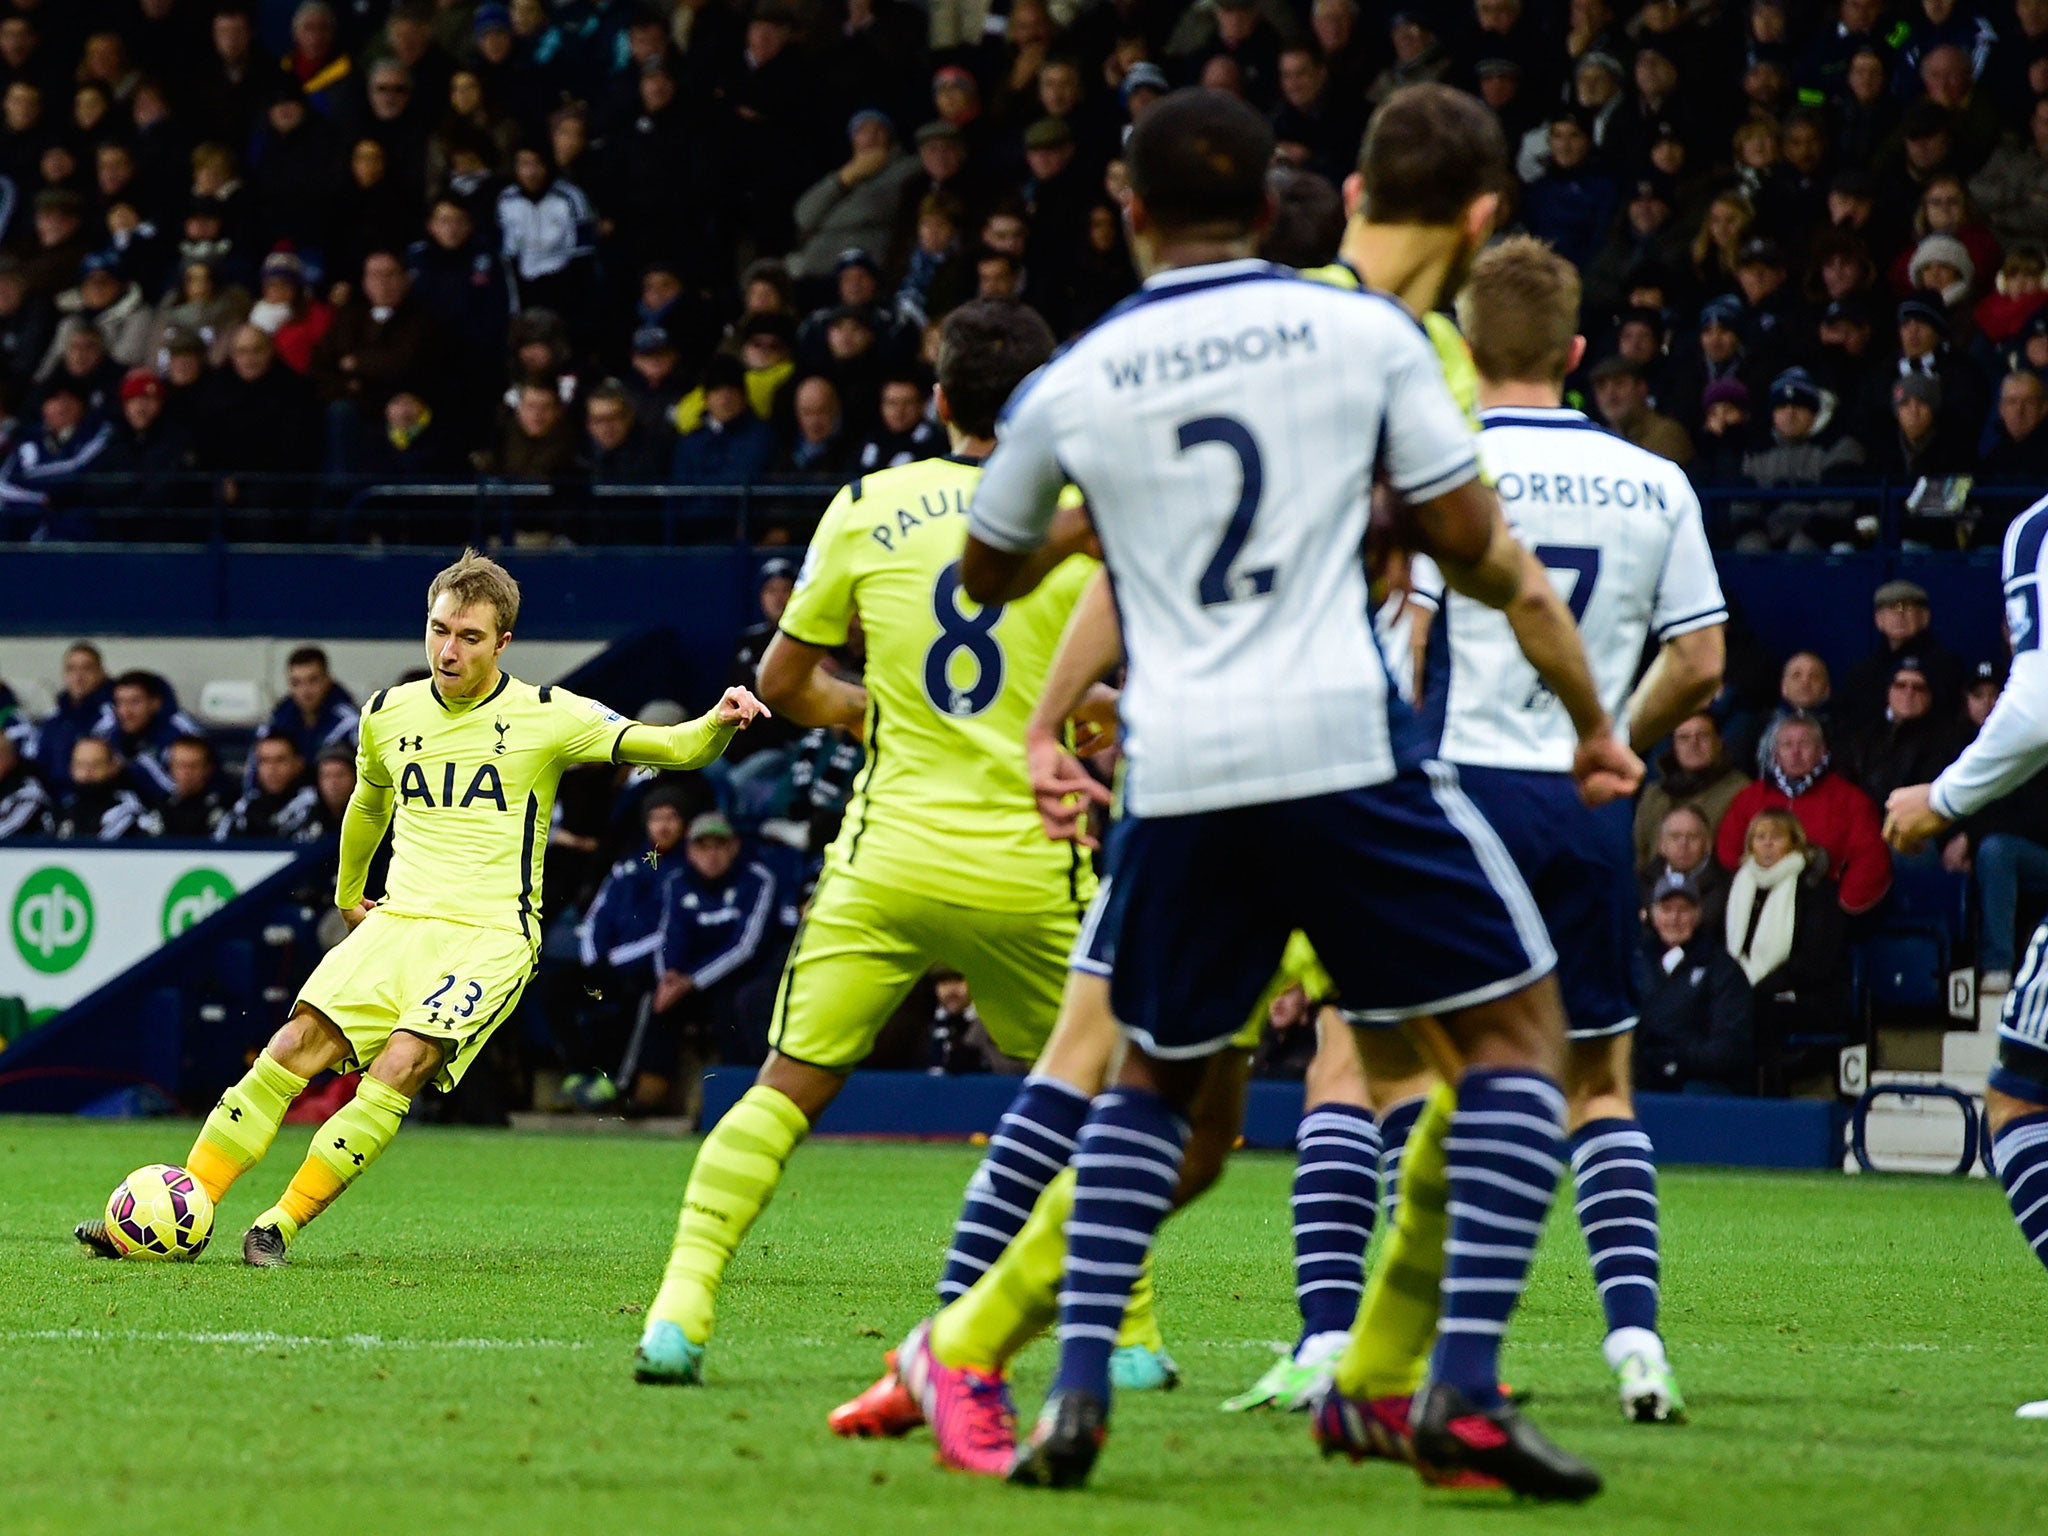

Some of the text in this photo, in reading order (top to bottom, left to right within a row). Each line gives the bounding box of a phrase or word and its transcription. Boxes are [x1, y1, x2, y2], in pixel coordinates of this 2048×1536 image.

[1103, 319, 1318, 390] WISDOM
[1177, 416, 1277, 606] 2
[924, 558, 1006, 717] 8
[401, 762, 508, 812] AIA
[422, 974, 483, 1018] 23
[1953, 978, 1970, 1009] D
[1844, 1055, 1861, 1086] C
